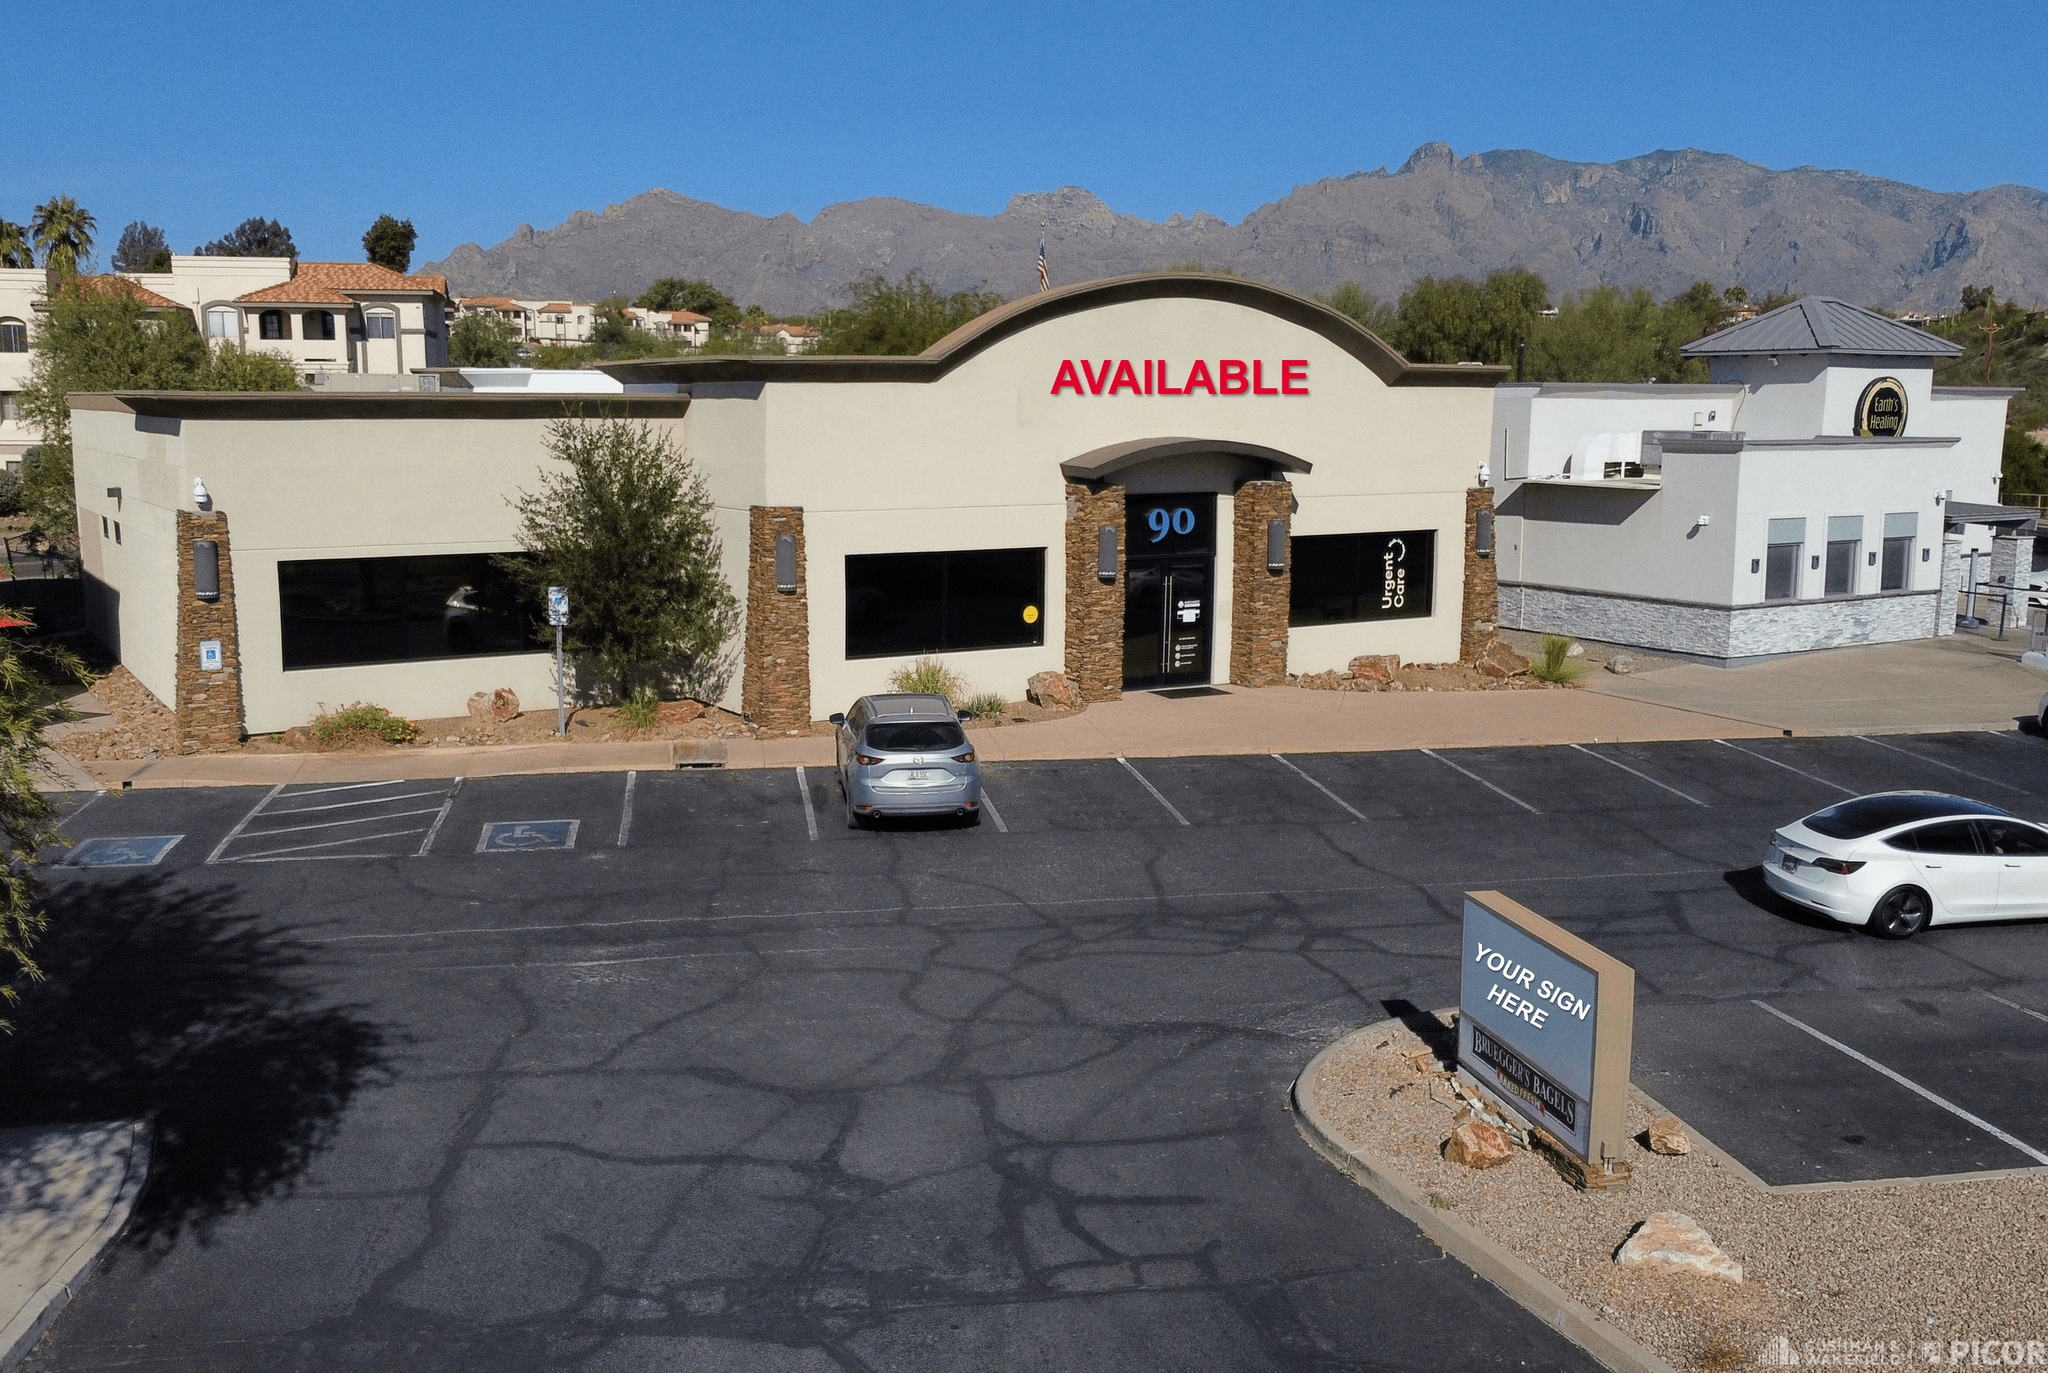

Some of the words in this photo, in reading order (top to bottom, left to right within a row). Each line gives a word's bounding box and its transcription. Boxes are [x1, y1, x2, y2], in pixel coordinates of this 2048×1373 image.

[1870, 415, 1899, 430] Healing
[1874, 397, 1899, 412] Earth's
[1148, 508, 1195, 543] 90
[1381, 552, 1396, 609] Urgent
[1394, 568, 1406, 608] Care
[1474, 1030, 1531, 1088] BRUEGGER'S
[1533, 1075, 1574, 1125] BAGELS
[1499, 1073, 1519, 1096] BAKED
[1519, 1087, 1540, 1110] FRESH
